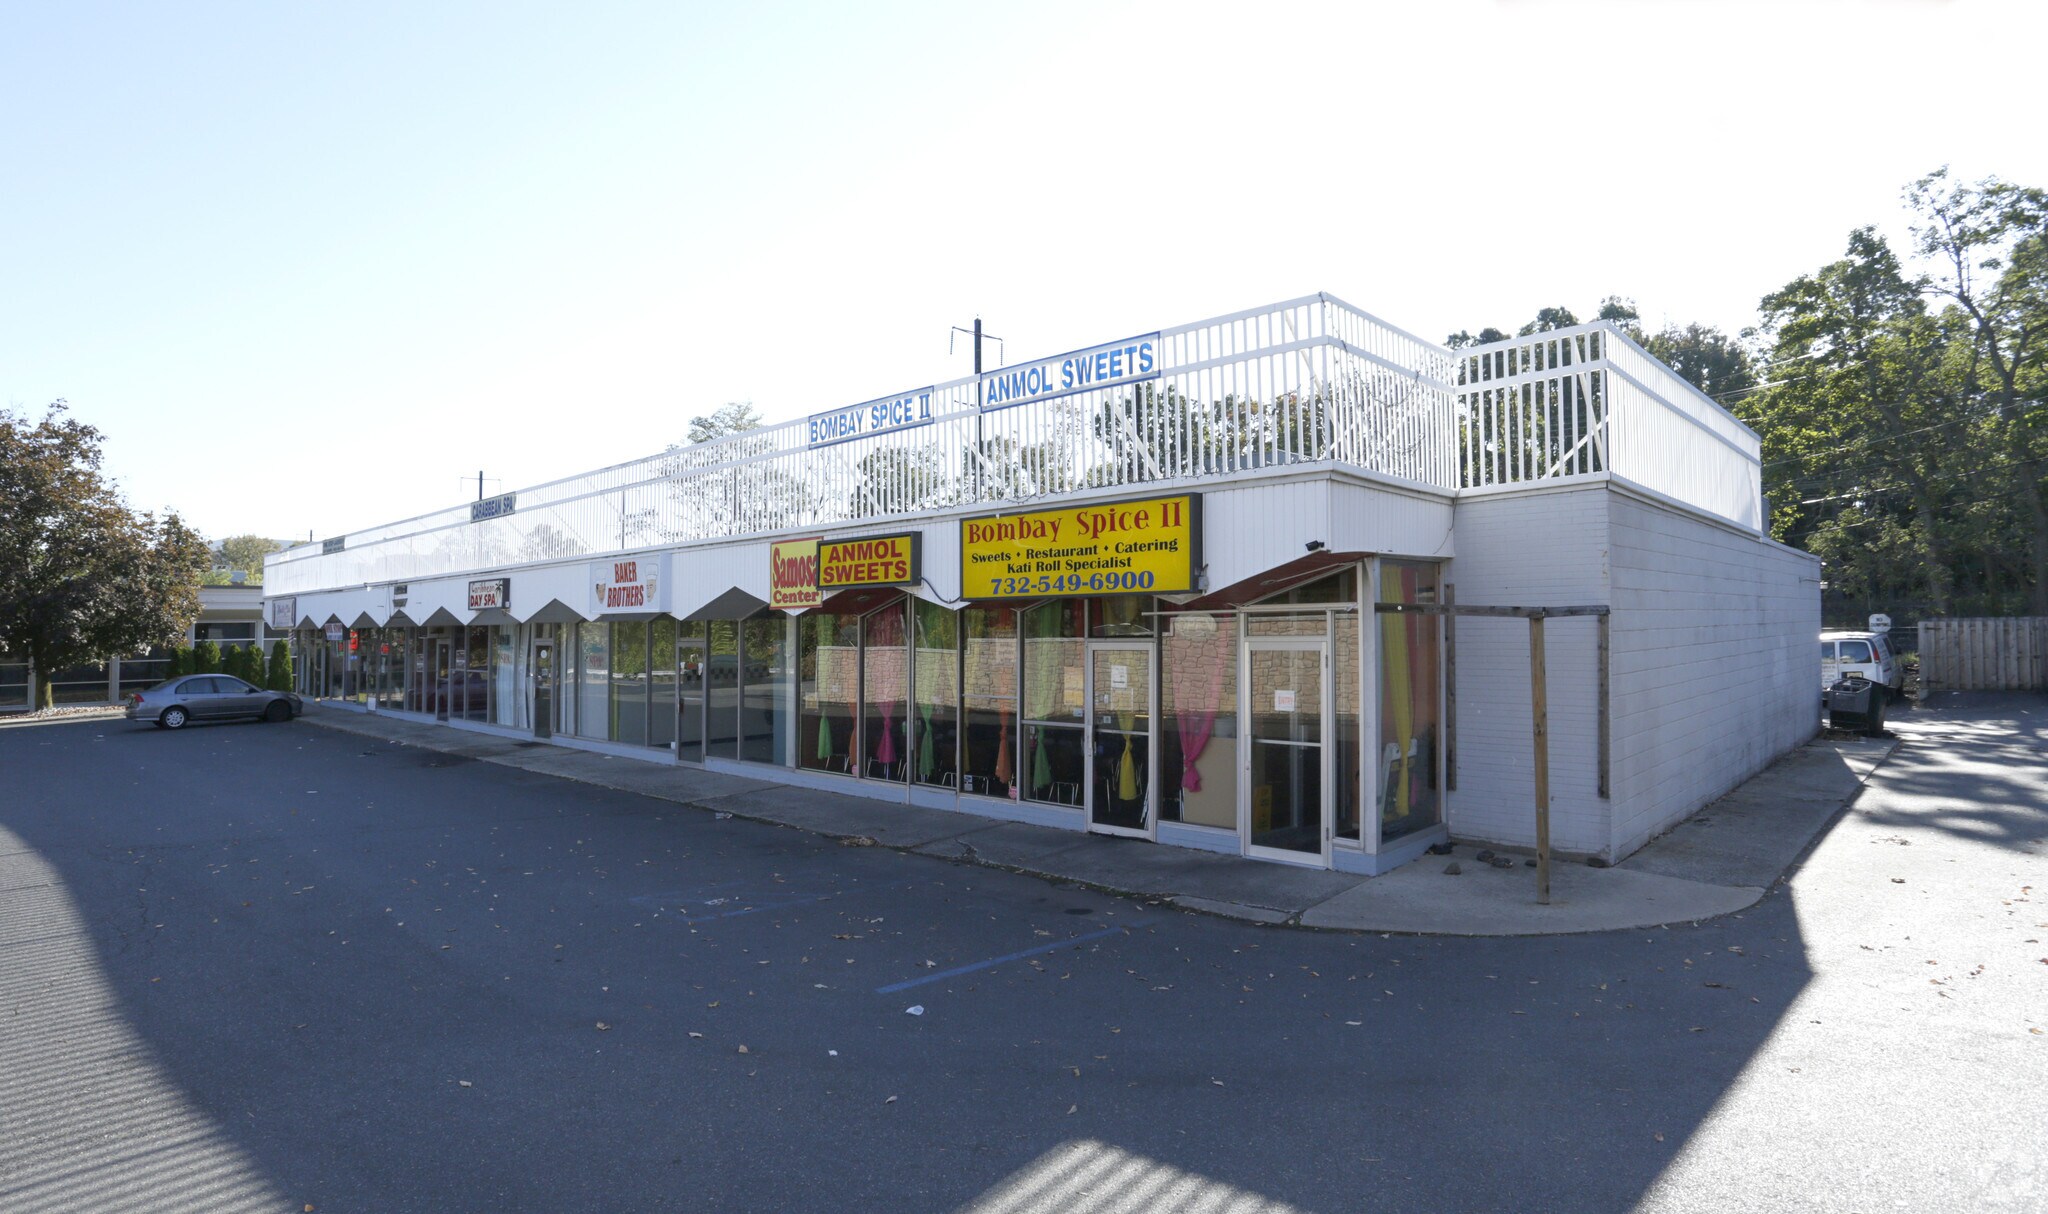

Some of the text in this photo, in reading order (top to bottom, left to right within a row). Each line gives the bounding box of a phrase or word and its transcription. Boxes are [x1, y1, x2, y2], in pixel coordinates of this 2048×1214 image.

[986, 343, 1153, 404] ANMOL SWEETS
[810, 393, 931, 442] BOMBAY SPICE II
[503, 496, 513, 513] SPA
[967, 501, 1182, 544] Bombay Spice II
[828, 539, 902, 563] ANMOL
[971, 538, 1178, 563] Sweets Restaurant Catering
[614, 561, 637, 583] BAKER
[823, 560, 907, 583] SWEETS
[1007, 556, 1132, 573] Kati Roll Specialist
[991, 570, 1154, 595] 732-549-6900
[471, 593, 496, 607] DAY SPA
[607, 584, 644, 608] BROTHERS
[773, 588, 819, 604] Center
